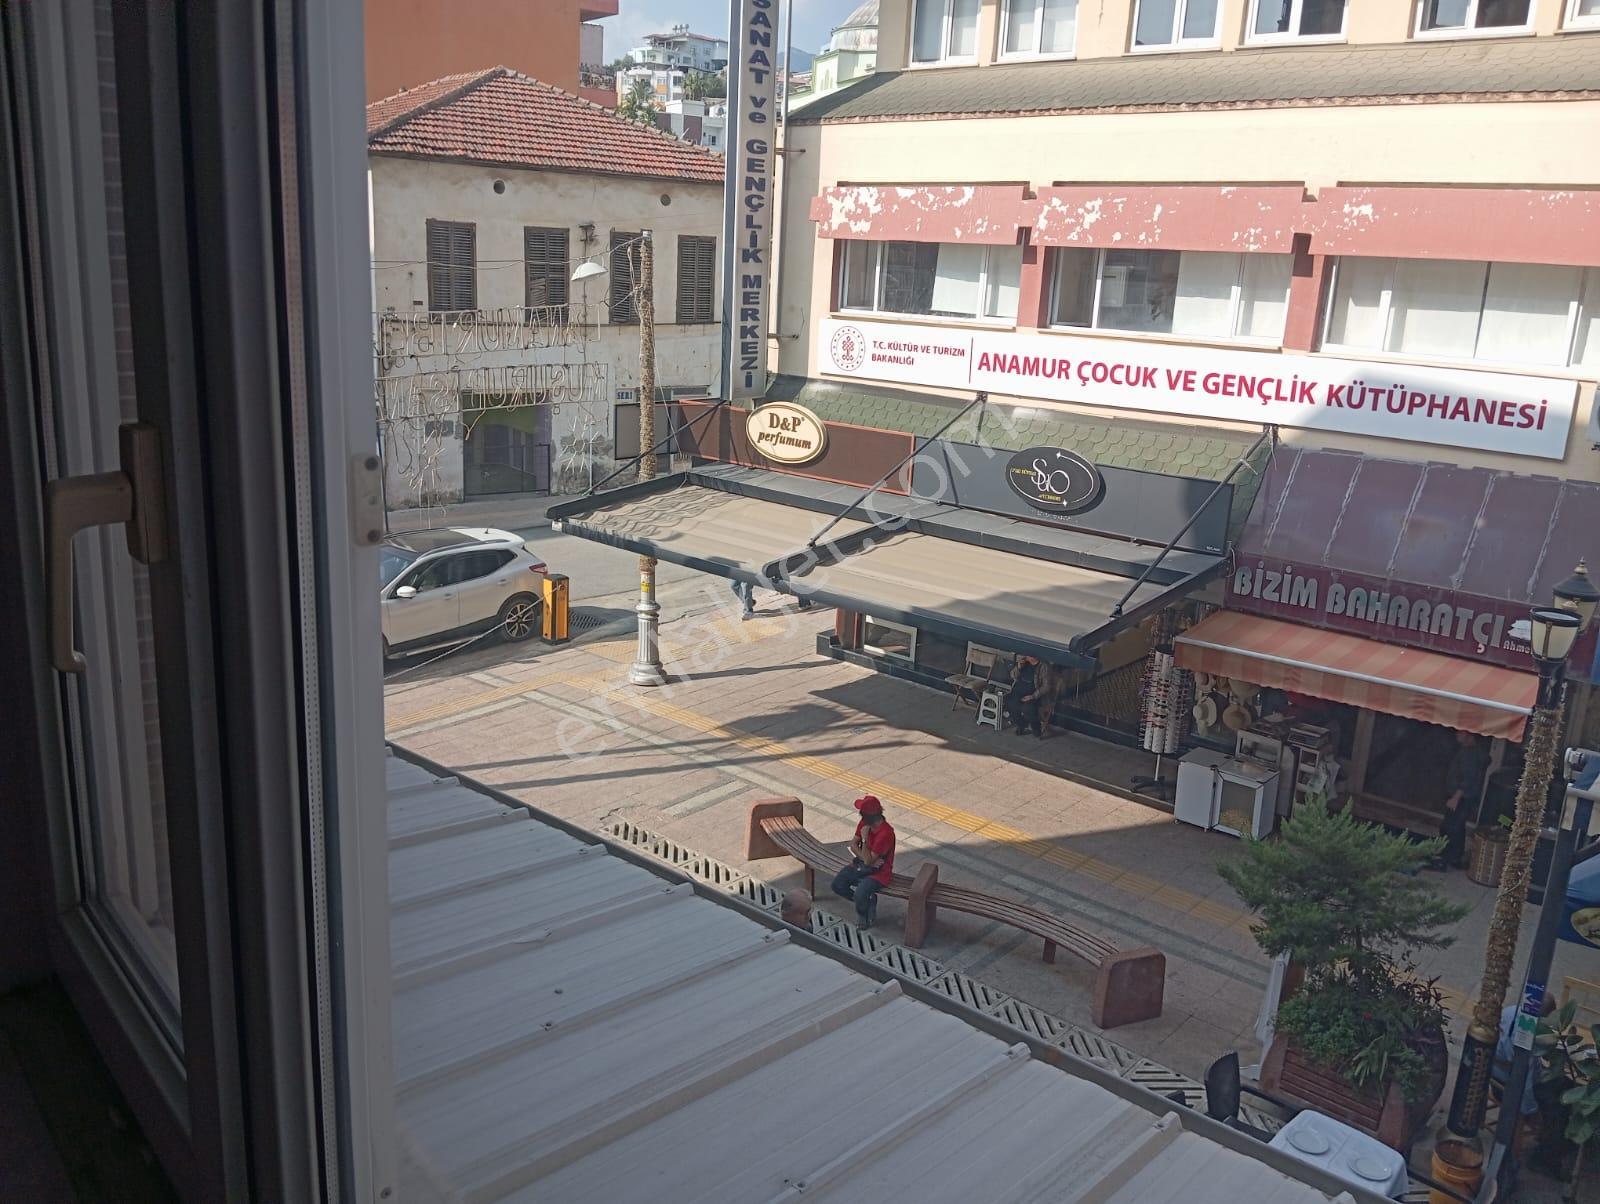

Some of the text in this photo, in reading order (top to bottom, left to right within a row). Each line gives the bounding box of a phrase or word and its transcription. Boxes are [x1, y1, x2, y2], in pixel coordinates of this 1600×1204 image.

[748, 96, 768, 123] ve
[742, 139, 768, 264] GENÇLİK
[740, 274, 763, 388] MERKEZİ
[871, 353, 915, 366] BAKANLIĞI
[887, 340, 919, 354] KÜLTÜR
[920, 344, 931, 355] VE
[932, 344, 966, 358] TURİZM
[977, 351, 1548, 431] ANAMUR ÇOCUK VE GENÇLİK KÜTÜPHANESİ
[768, 412, 802, 433] D&P
[757, 431, 812, 450] perfumum
[1233, 561, 1506, 654] BİZİM BAHARATÇI
[1503, 639, 1533, 655] Ahme
